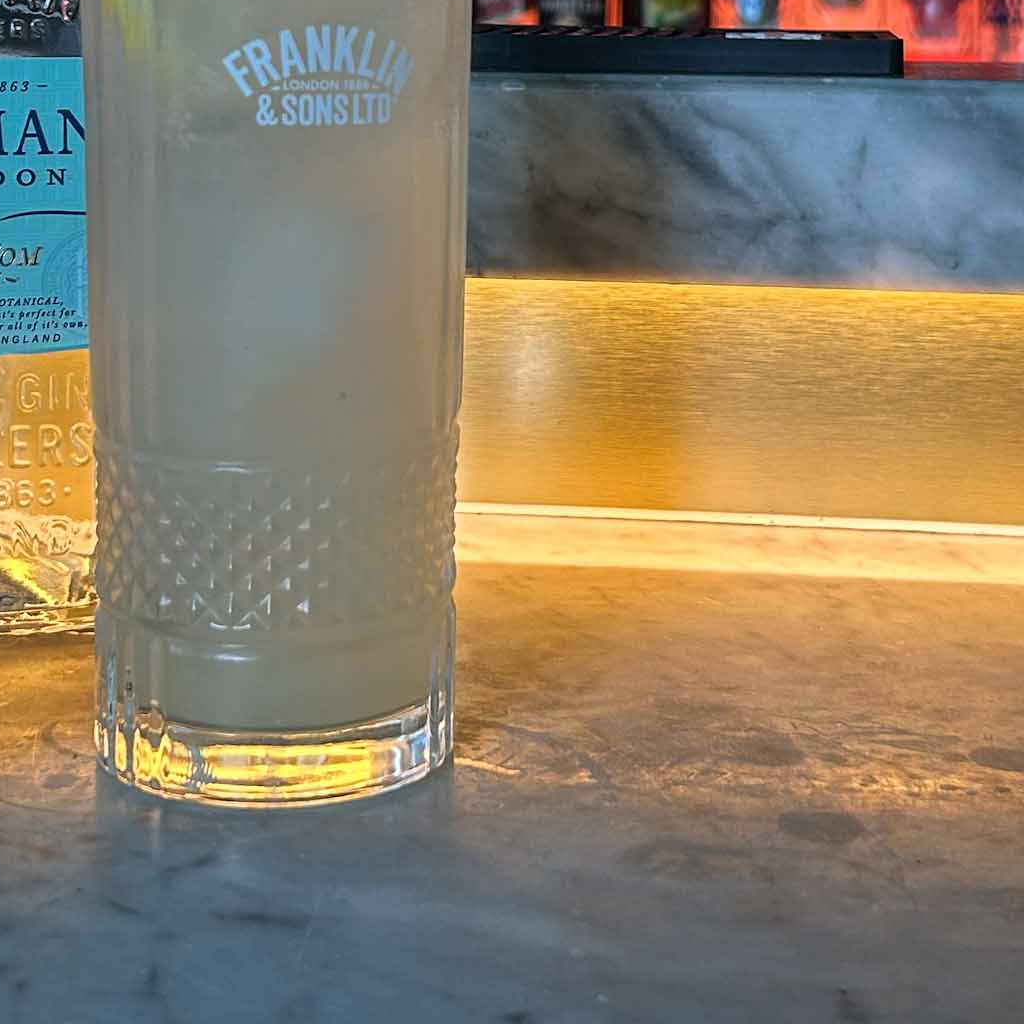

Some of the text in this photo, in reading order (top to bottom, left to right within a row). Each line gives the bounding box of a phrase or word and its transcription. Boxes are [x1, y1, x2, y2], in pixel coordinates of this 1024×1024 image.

[222, 23, 416, 97] FRANKLIN
[255, 93, 392, 127] & SONS LTD
[18, 309, 57, 321] perfect
[58, 307, 77, 319] for
[7, 321, 23, 331] all
[27, 321, 38, 332] of
[42, 321, 59, 329] it's
